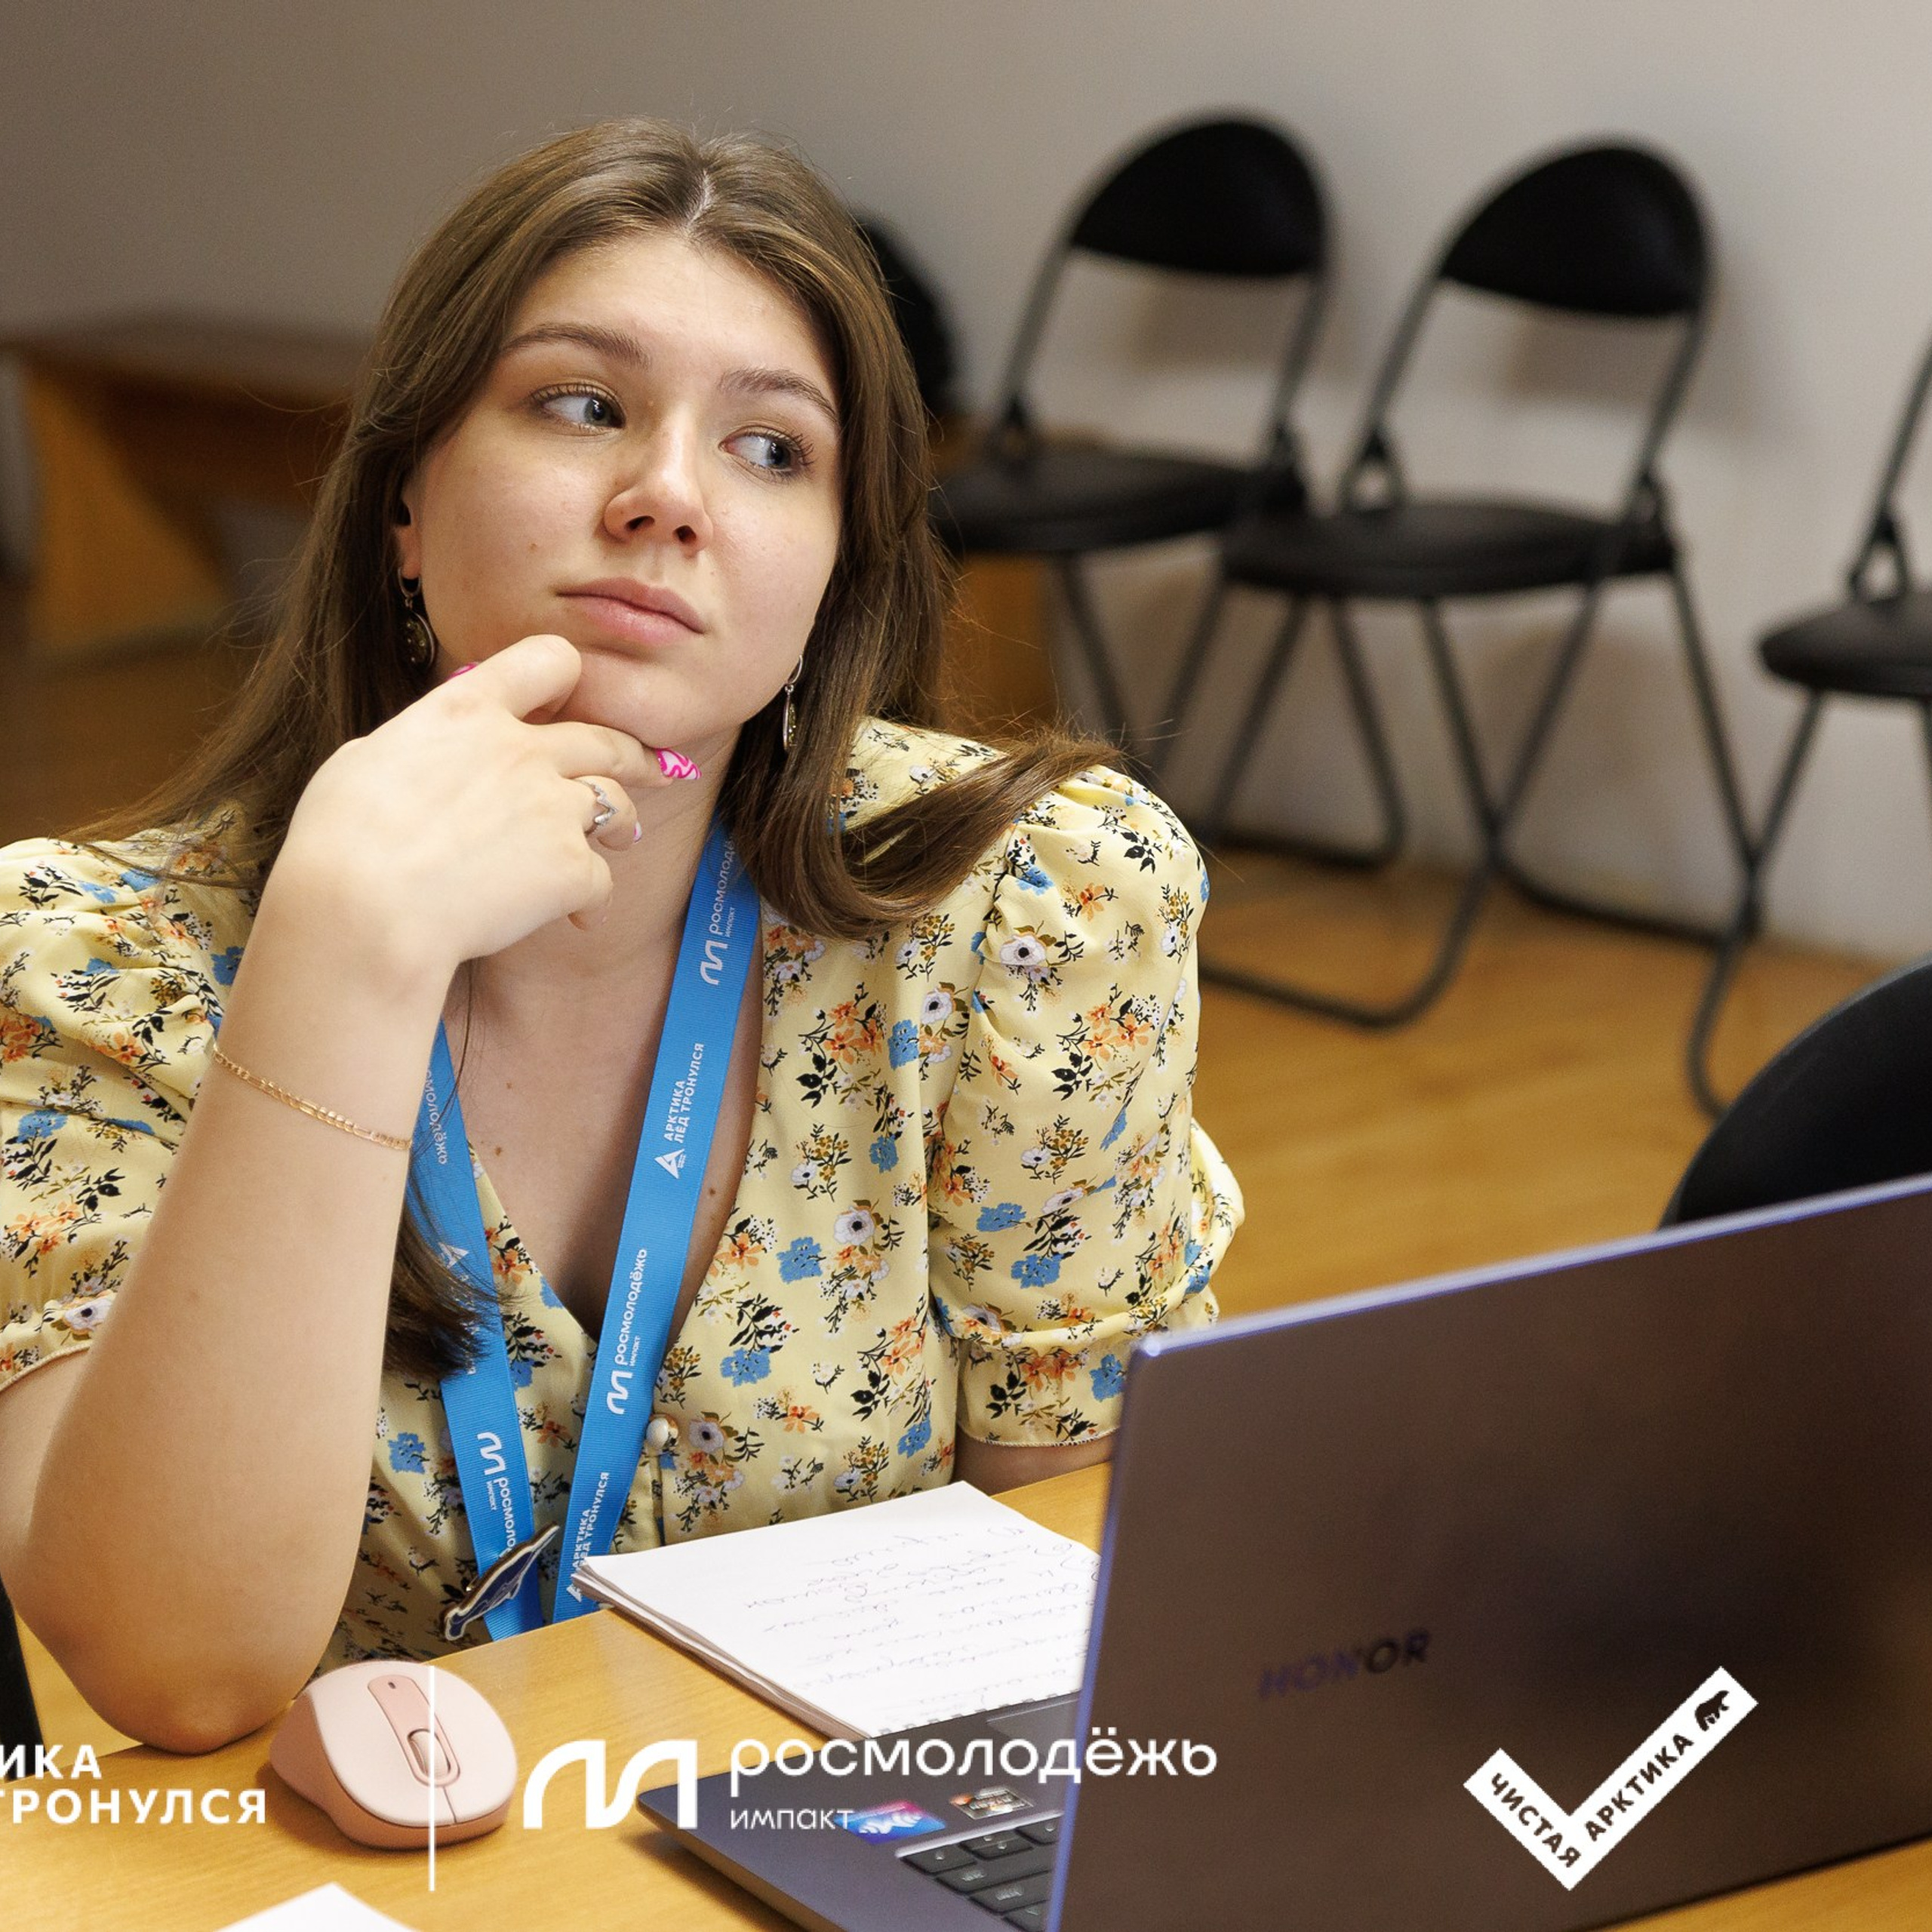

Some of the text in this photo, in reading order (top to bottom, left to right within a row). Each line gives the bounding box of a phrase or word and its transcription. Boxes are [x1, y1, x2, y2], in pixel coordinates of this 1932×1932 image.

[681, 1042, 705, 1112] ТРОНУЛСЯ
[664, 1080, 686, 1142] АРКТИКА
[614, 1248, 648, 1365] росмолодёжь
[584, 1472, 610, 1538] ТРОНУЛСЯ
[572, 1509, 591, 1569] АРКТИКА
